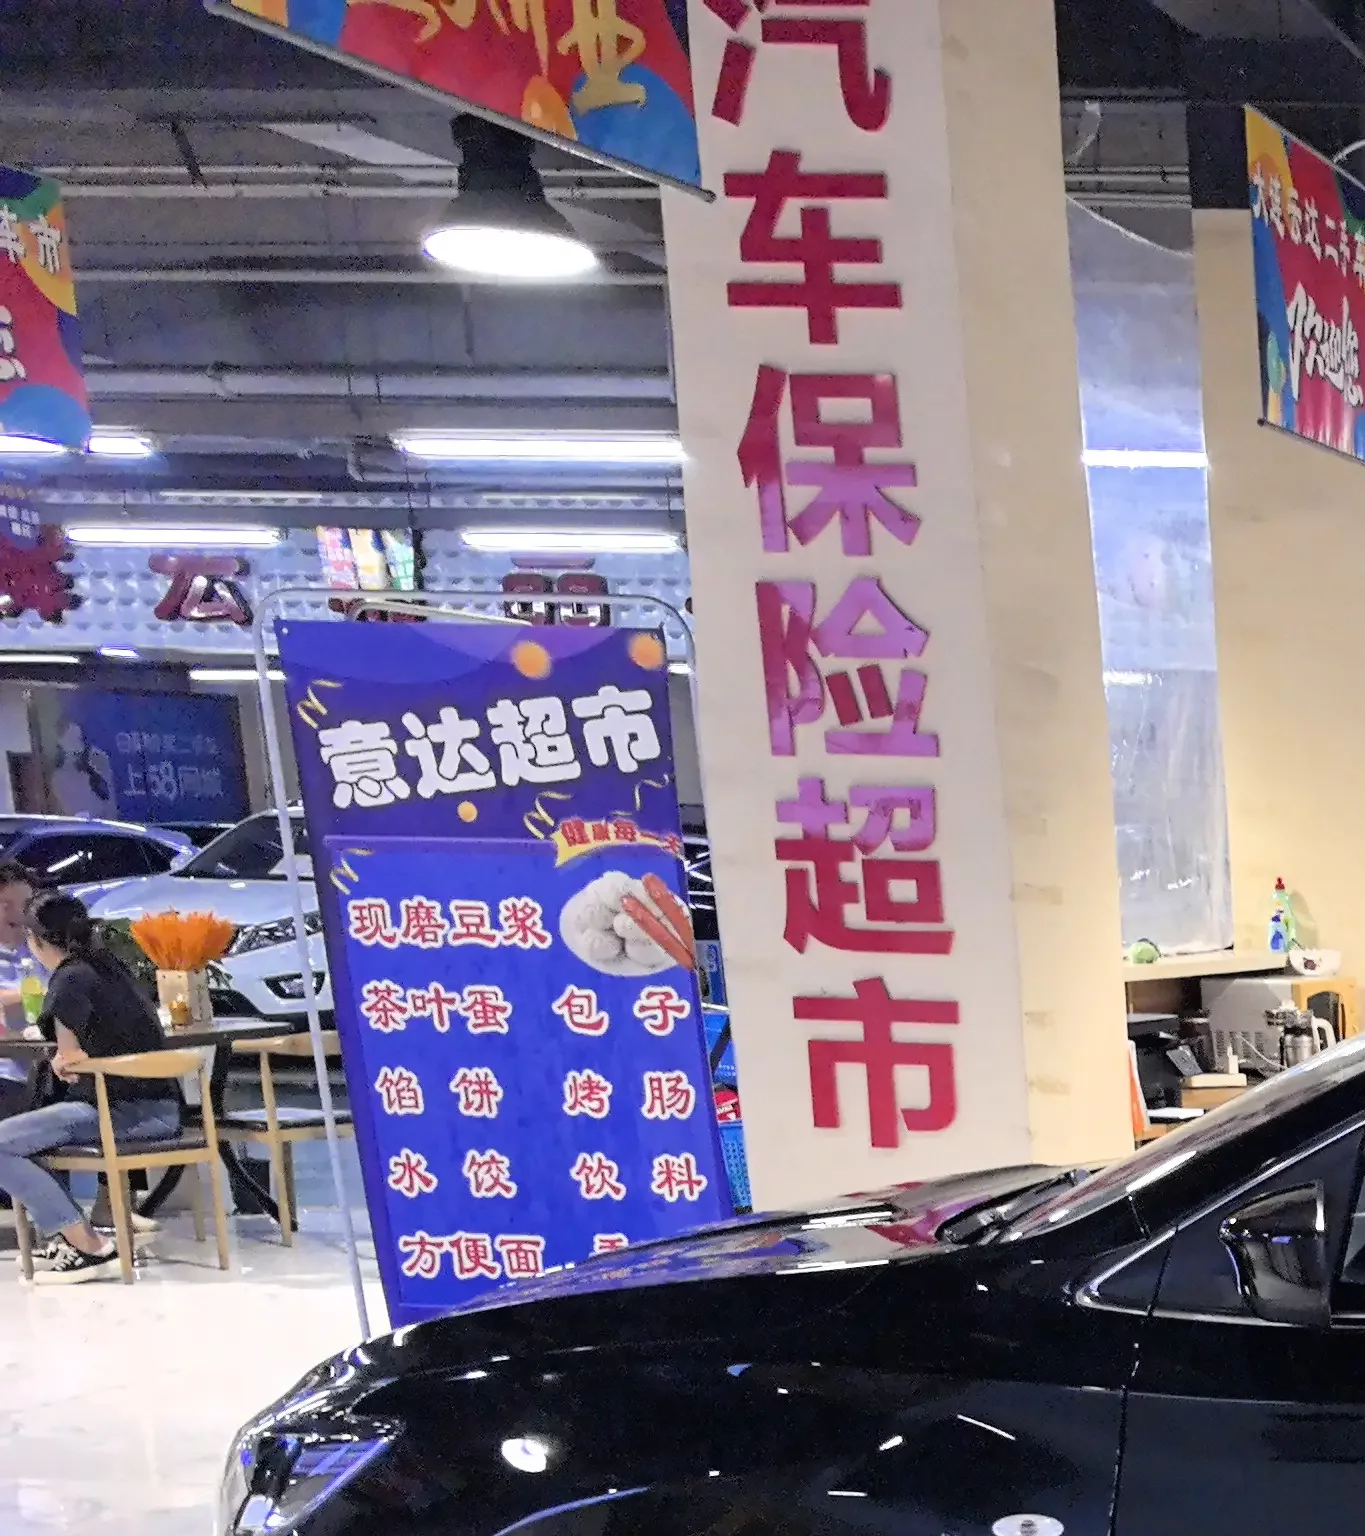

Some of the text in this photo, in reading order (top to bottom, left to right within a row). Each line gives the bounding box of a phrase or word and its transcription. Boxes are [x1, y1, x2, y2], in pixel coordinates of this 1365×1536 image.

[711, 0, 960, 1148] 汽车保险超市
[318, 685, 662, 809] 意达超市
[349, 896, 553, 948] 现磨豆浆
[362, 980, 691, 1036] 茶叶蛋 包子
[375, 1066, 696, 1120] 馅饼 烤肠
[388, 1148, 708, 1202] 水饺 饮料
[400, 1230, 545, 1280] 方便面
